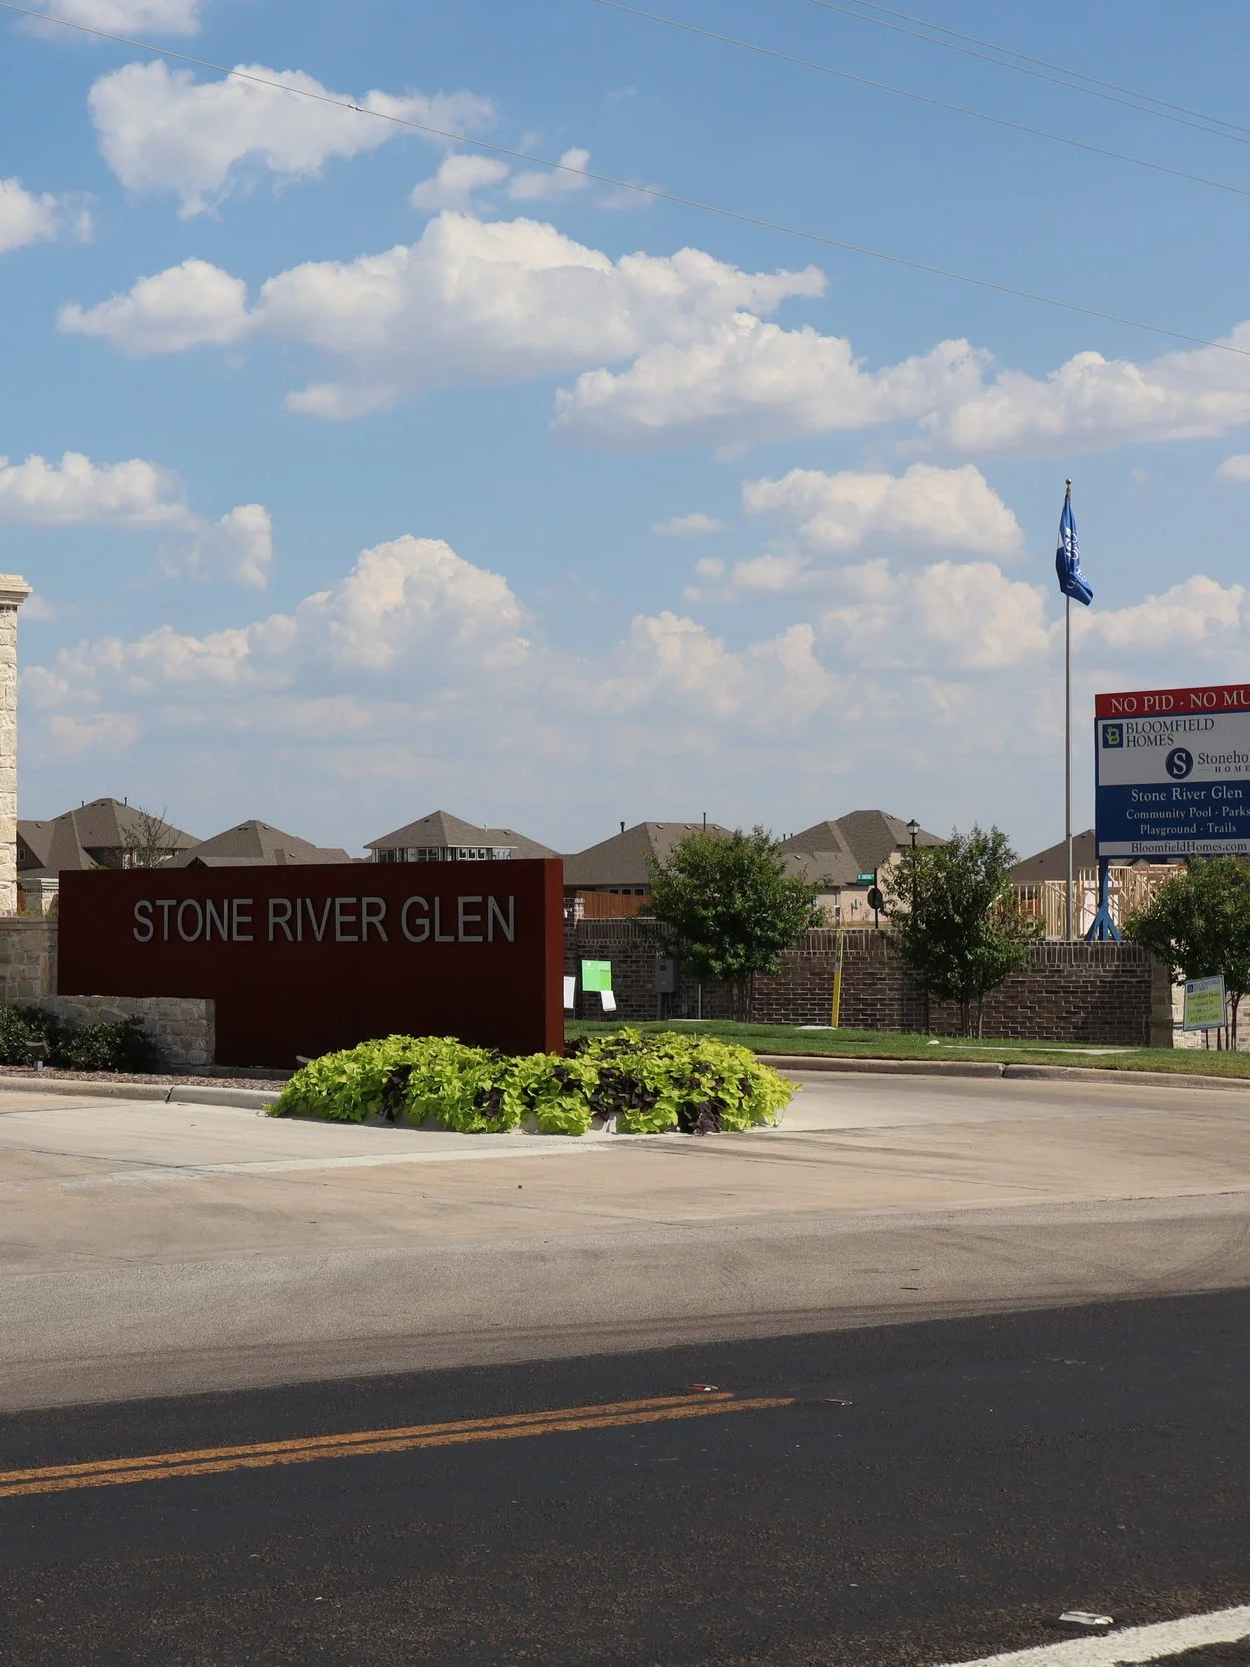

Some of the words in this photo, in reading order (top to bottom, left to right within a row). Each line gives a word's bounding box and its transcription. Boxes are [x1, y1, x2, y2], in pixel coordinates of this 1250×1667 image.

[1110, 697, 1137, 713] NO
[1143, 695, 1174, 711] PID
[1190, 692, 1217, 708] NO
[1126, 718, 1215, 734] BLOOMFIELD
[1126, 734, 1174, 748] HOMES
[1173, 752, 1187, 775] S
[1198, 749, 1250, 765] Stoneho
[1131, 788, 1167, 802] Stone
[1172, 787, 1207, 801] River
[1211, 785, 1243, 799] Glen
[1126, 808, 1186, 819] Community
[1189, 806, 1212, 818] Pool
[1222, 805, 1250, 817] Parks
[1140, 822, 1197, 836] Playground
[1206, 821, 1237, 833] Trails
[1131, 841, 1247, 853] BloomfieldHomes.com
[133, 899, 253, 942] STONE
[267, 897, 389, 942] RIVER
[401, 896, 515, 942] GLEN
